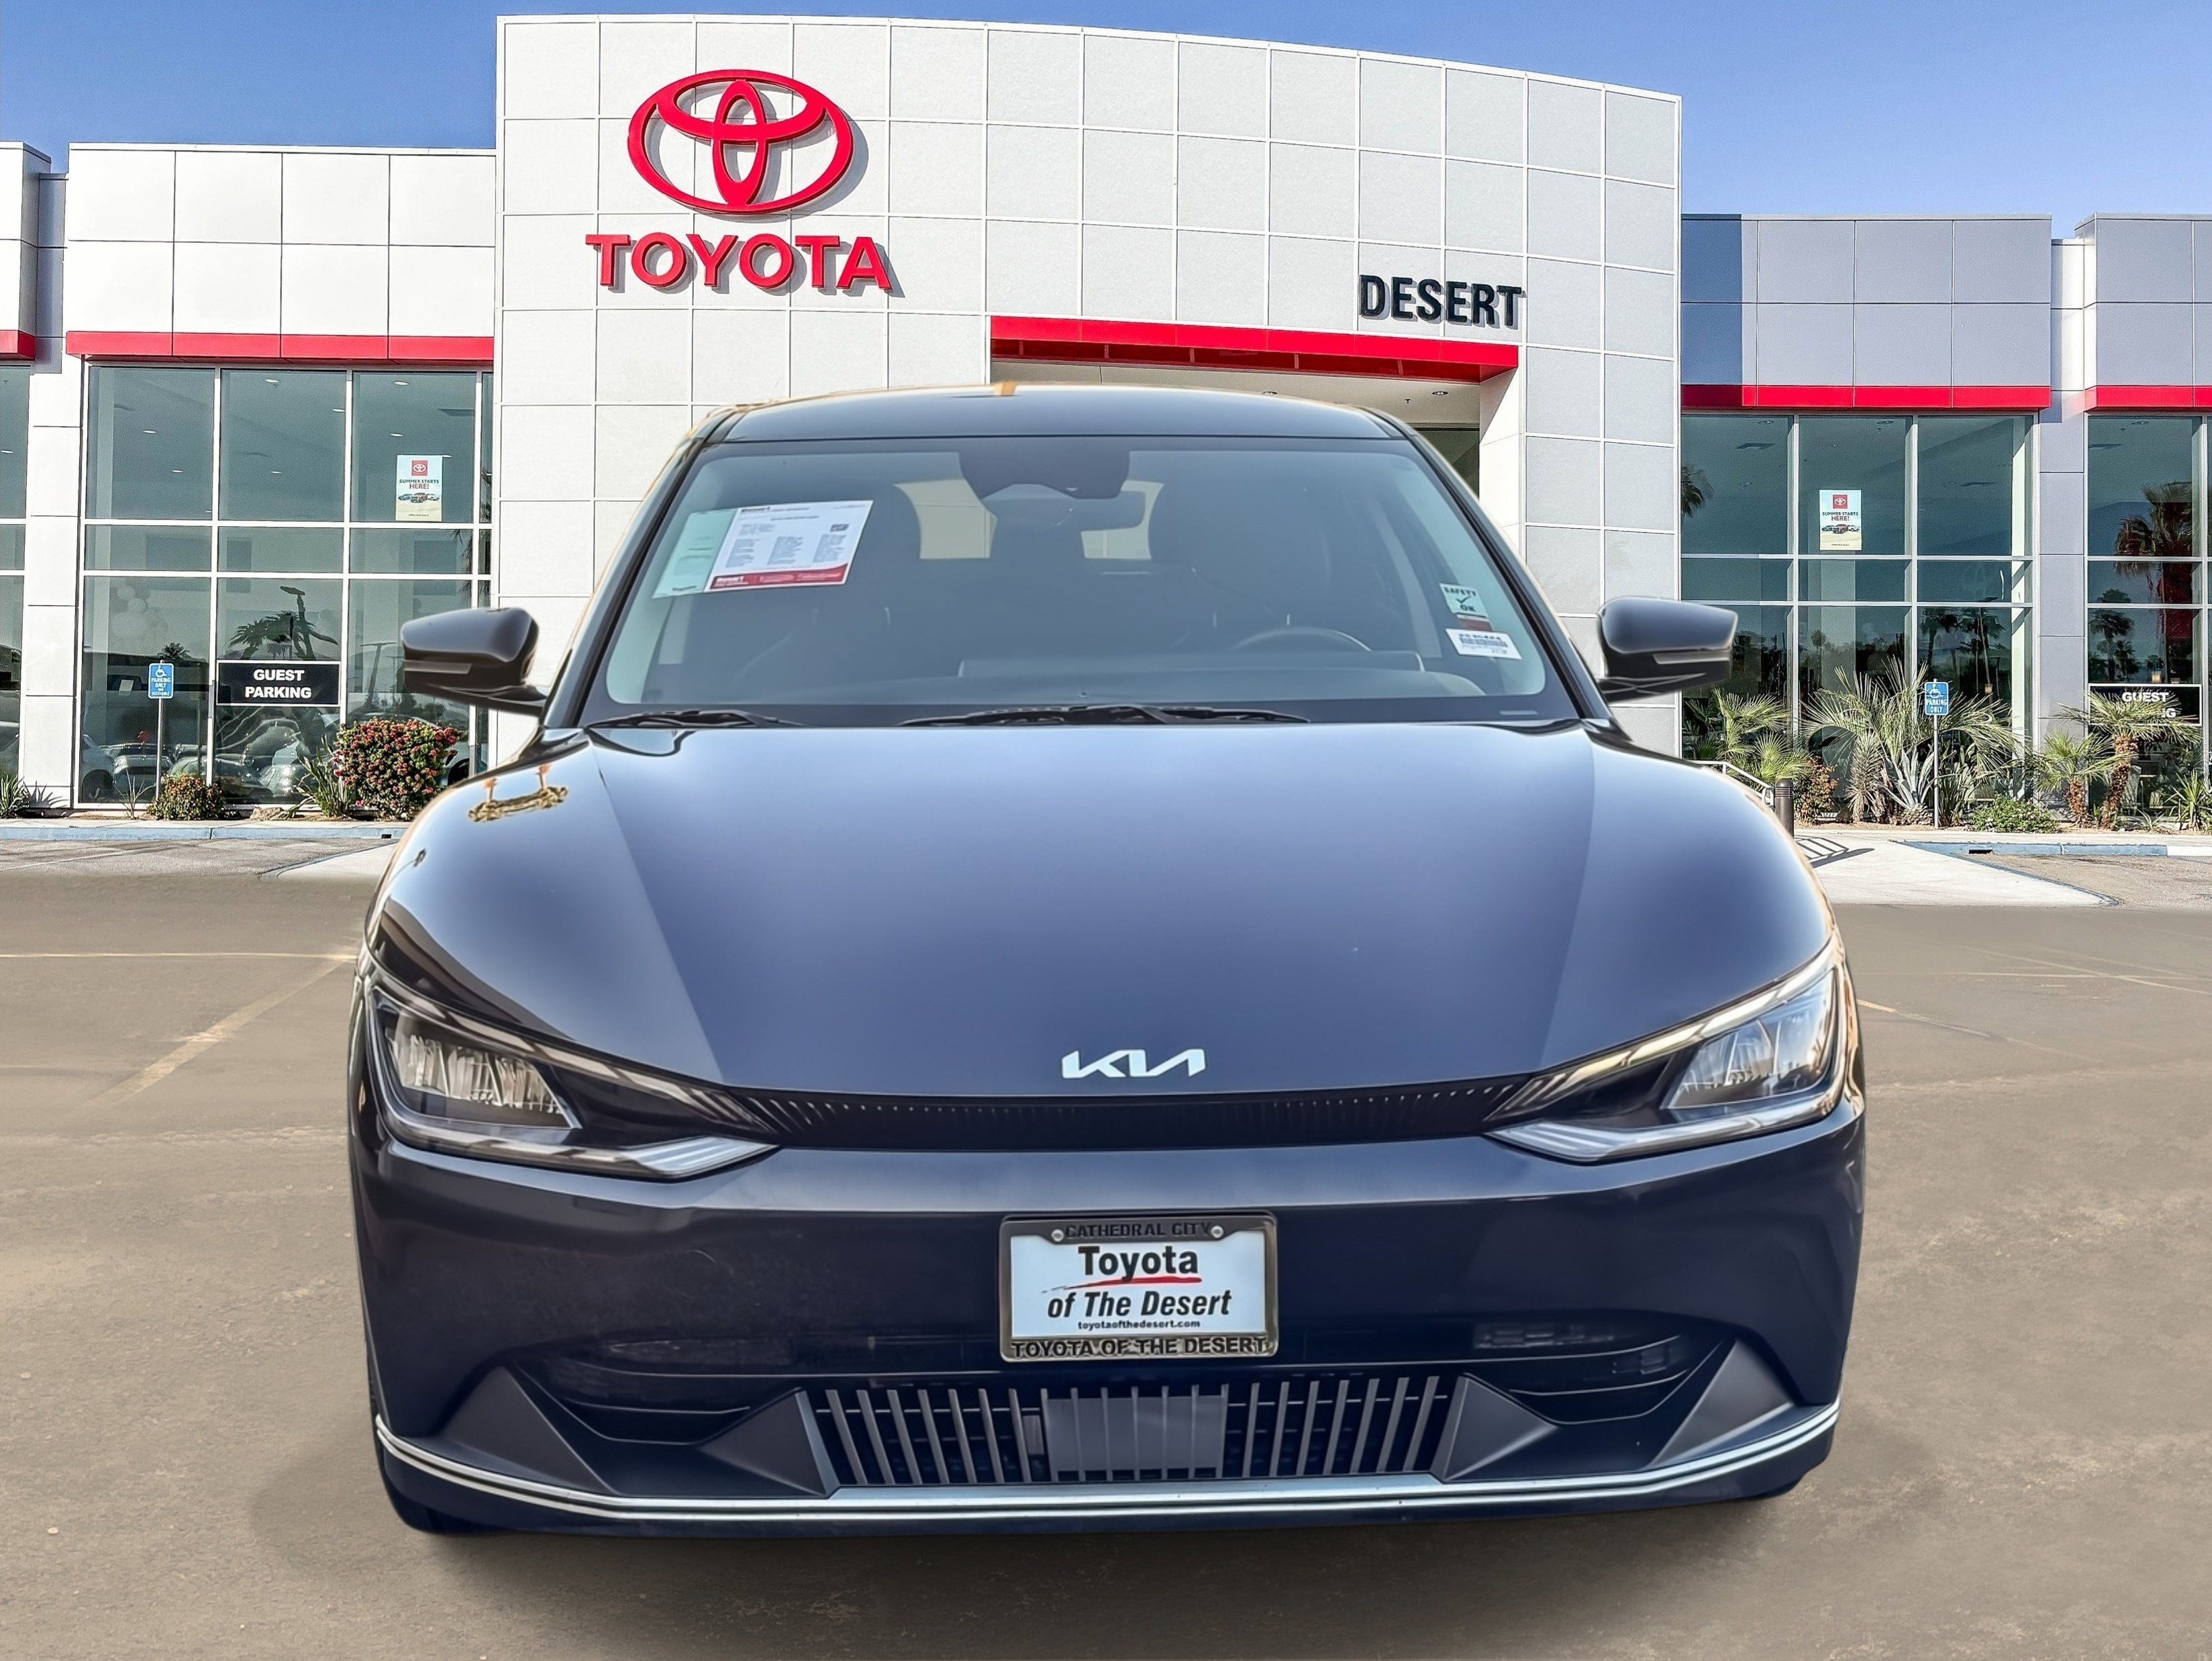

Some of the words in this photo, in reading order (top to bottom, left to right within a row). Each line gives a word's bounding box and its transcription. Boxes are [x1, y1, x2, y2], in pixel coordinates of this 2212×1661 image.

[585, 232, 893, 290] TOYOTA
[1359, 274, 1522, 326] DESERT
[1444, 587, 1476, 597] SAFETY
[253, 669, 305, 681] GUEST
[245, 687, 312, 699] PARKING
[2122, 692, 2169, 703] GUEST
[1930, 705, 1944, 713] ONLY
[1065, 1222, 1166, 1240] CATHEDRAL
[1172, 1221, 1212, 1236] CITY
[1078, 1246, 1199, 1282] Toyota
[1048, 1291, 1076, 1317] of
[1085, 1291, 1132, 1317] The
[1141, 1290, 1232, 1315] Desert
[1078, 1319, 1201, 1331] toyotaofthedesert.com
[1011, 1341, 1093, 1358] TOYOTA
[1102, 1340, 1131, 1355] OF
[1138, 1339, 1178, 1354] THE
[1185, 1336, 1267, 1354] DESERT
